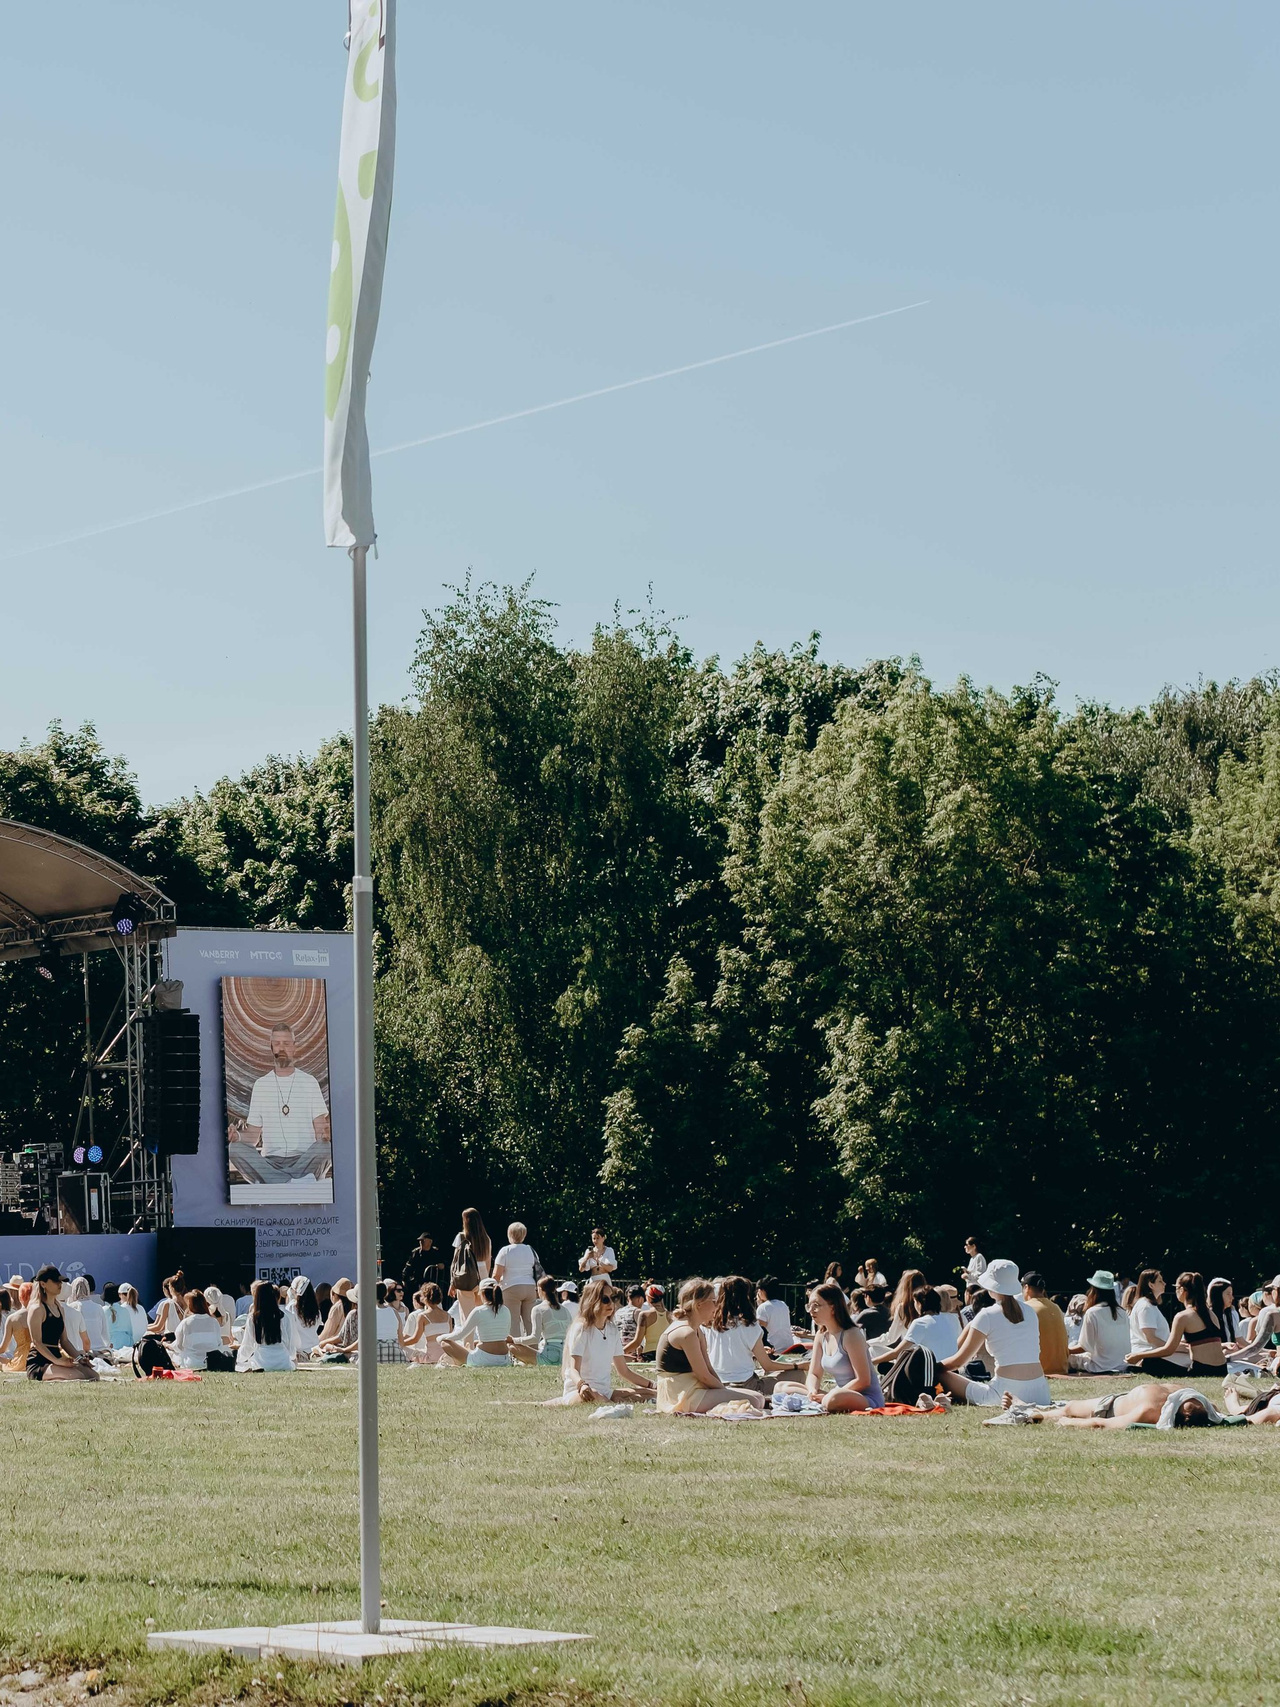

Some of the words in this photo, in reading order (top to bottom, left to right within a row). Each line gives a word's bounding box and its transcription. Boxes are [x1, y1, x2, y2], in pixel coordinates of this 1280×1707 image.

[199, 949, 240, 960] VANBERRY
[214, 1216, 264, 1227] СКАНИРУЙТЕ
[296, 1217, 302, 1225] И
[304, 1216, 340, 1225] ЗАХОДИТЕ
[258, 1229, 274, 1237] ВАС
[296, 1227, 331, 1236] ПОДАРОК
[291, 1238, 319, 1247] ПРИЗОВ
[323, 1249, 338, 1257] 17:00
